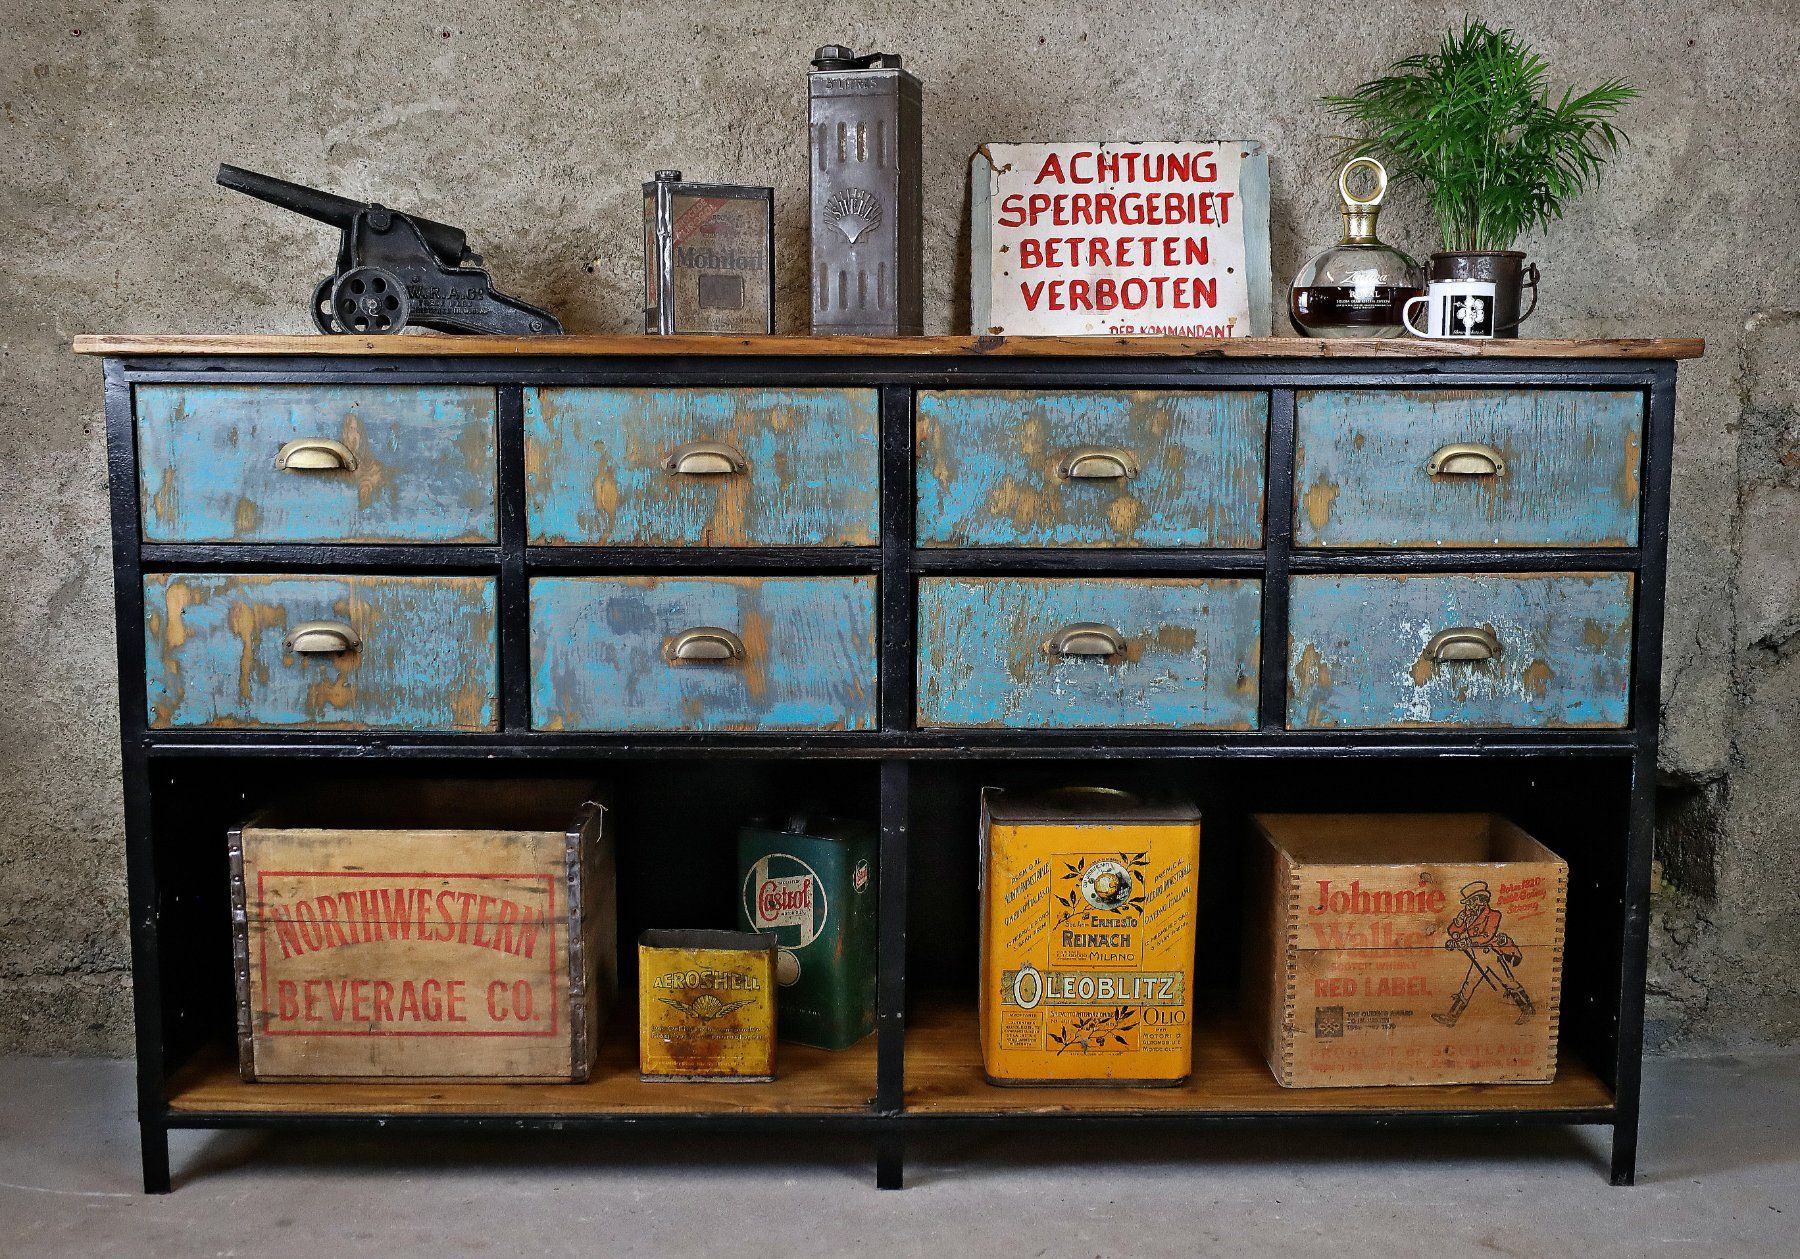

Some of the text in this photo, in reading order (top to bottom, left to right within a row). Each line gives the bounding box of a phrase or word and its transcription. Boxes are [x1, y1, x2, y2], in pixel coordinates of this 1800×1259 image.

[1034, 150, 1218, 185] ACHTUNG
[831, 197, 880, 221] SHELL
[997, 191, 1235, 228] SPERRGEBIET
[1020, 235, 1209, 269] BETRETEN
[1020, 276, 1217, 311] VERBOTEN
[1140, 323, 1235, 338] KOMMANDANT
[758, 878, 811, 922] Castrol
[1307, 879, 1446, 916] Johnnie
[270, 887, 544, 961] NORTHWESTERN
[1062, 929, 1131, 948] REINACH
[1091, 915, 1138, 928] ERNESTO
[1089, 951, 1135, 962] MILANO
[1308, 921, 1443, 959] Walker
[653, 969, 761, 991] AEROSHELL
[1013, 966, 1175, 1009] OLEOBLITZ
[1314, 976, 1433, 998] RED LABEL
[278, 978, 541, 1023] BEVERAGE CO.
[1143, 1007, 1186, 1025] OLIO
